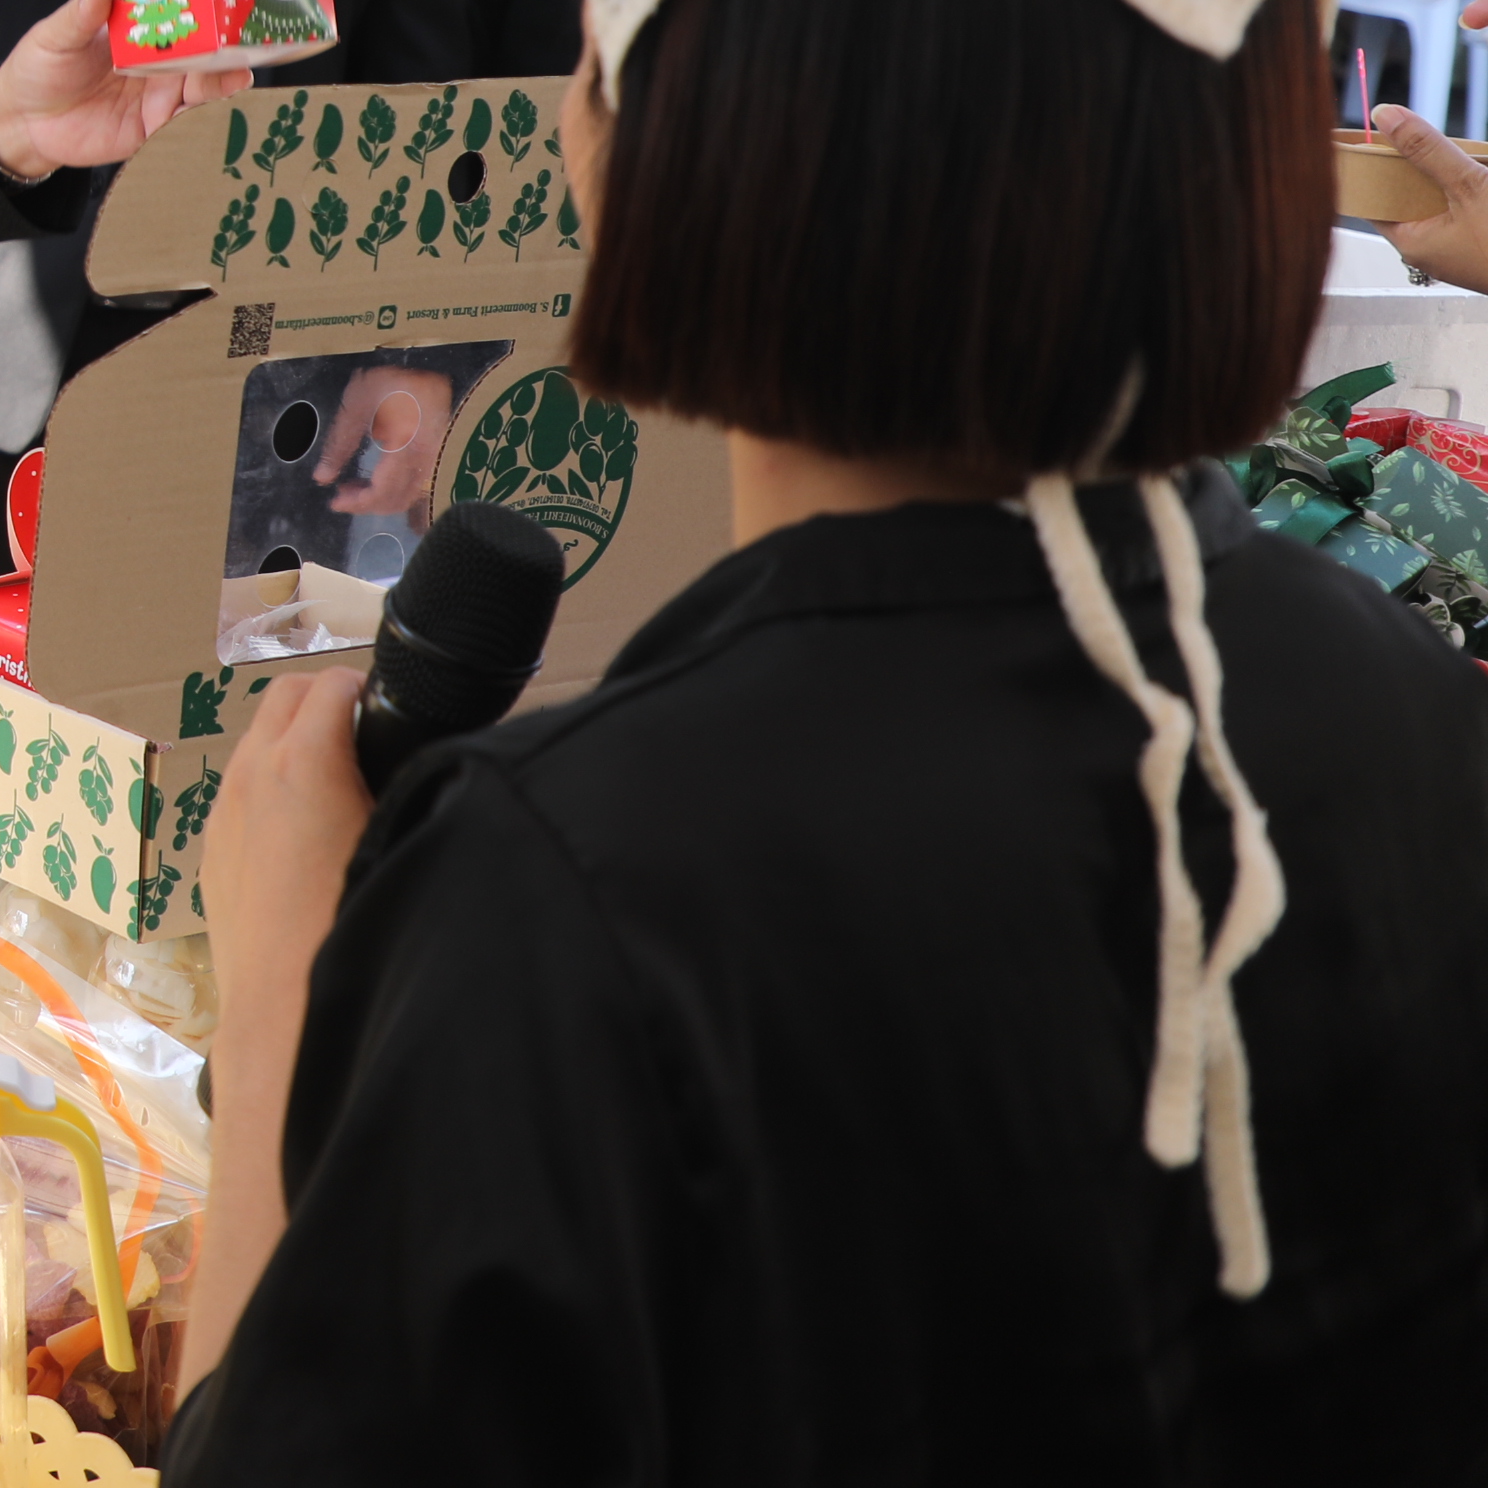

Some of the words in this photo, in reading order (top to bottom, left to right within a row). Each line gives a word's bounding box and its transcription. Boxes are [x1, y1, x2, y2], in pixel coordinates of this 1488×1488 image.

[406, 309, 439, 320] Resort
[441, 308, 450, 319] &
[452, 305, 479, 317] Farm
[481, 302, 537, 316] Boonmeerit
[275, 311, 375, 330] @s.boonmeeritfarm
[542, 511, 609, 539] S.BOONMEERIT
